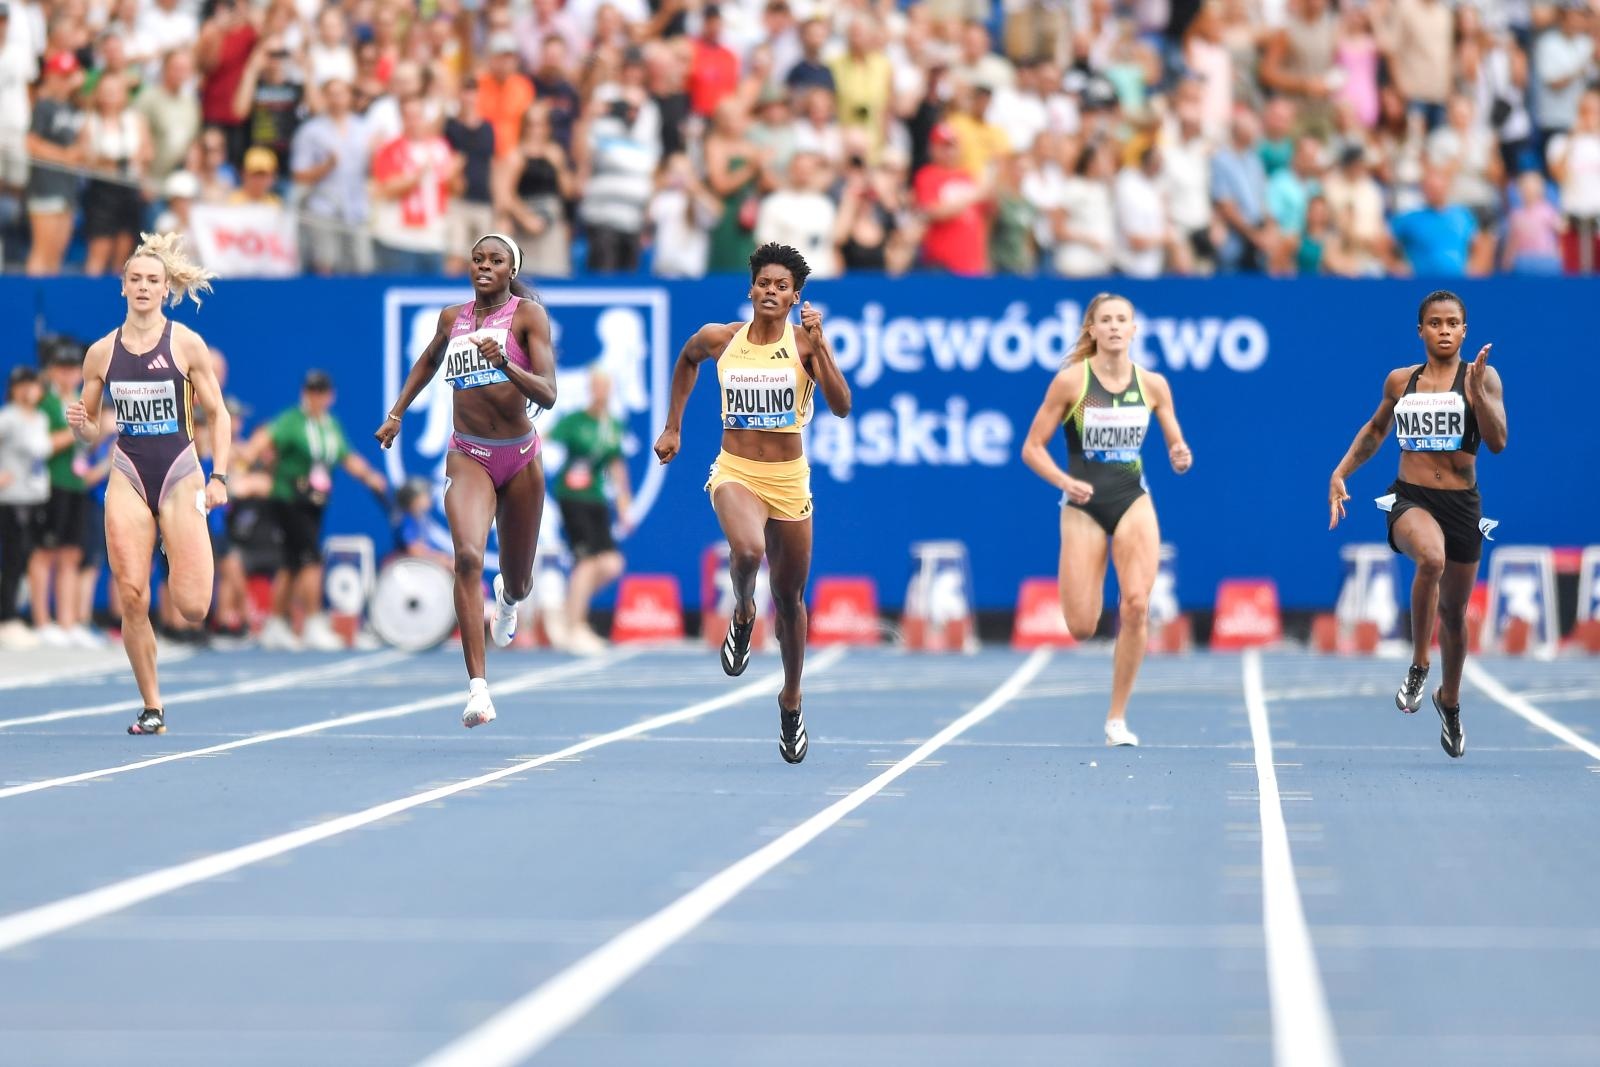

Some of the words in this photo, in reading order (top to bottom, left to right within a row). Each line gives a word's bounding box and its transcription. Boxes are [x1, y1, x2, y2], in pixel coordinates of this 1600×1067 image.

[739, 300, 1268, 387] ojewódtwo
[446, 344, 504, 377] ADELE
[464, 372, 501, 386] SILESIA
[730, 374, 788, 383] Poland.Travel
[116, 387, 167, 395] Poland.Travel
[726, 388, 794, 413] PAULINO
[1402, 397, 1456, 407] Poland.Travel
[115, 398, 175, 422] KLAVER
[747, 416, 788, 427] SILESIA
[1396, 412, 1461, 436] NASER
[132, 423, 170, 434] SILESIA
[1085, 427, 1145, 447] KACZMARE
[1416, 439, 1454, 449] SILESIA
[470, 447, 492, 457] KPMG
